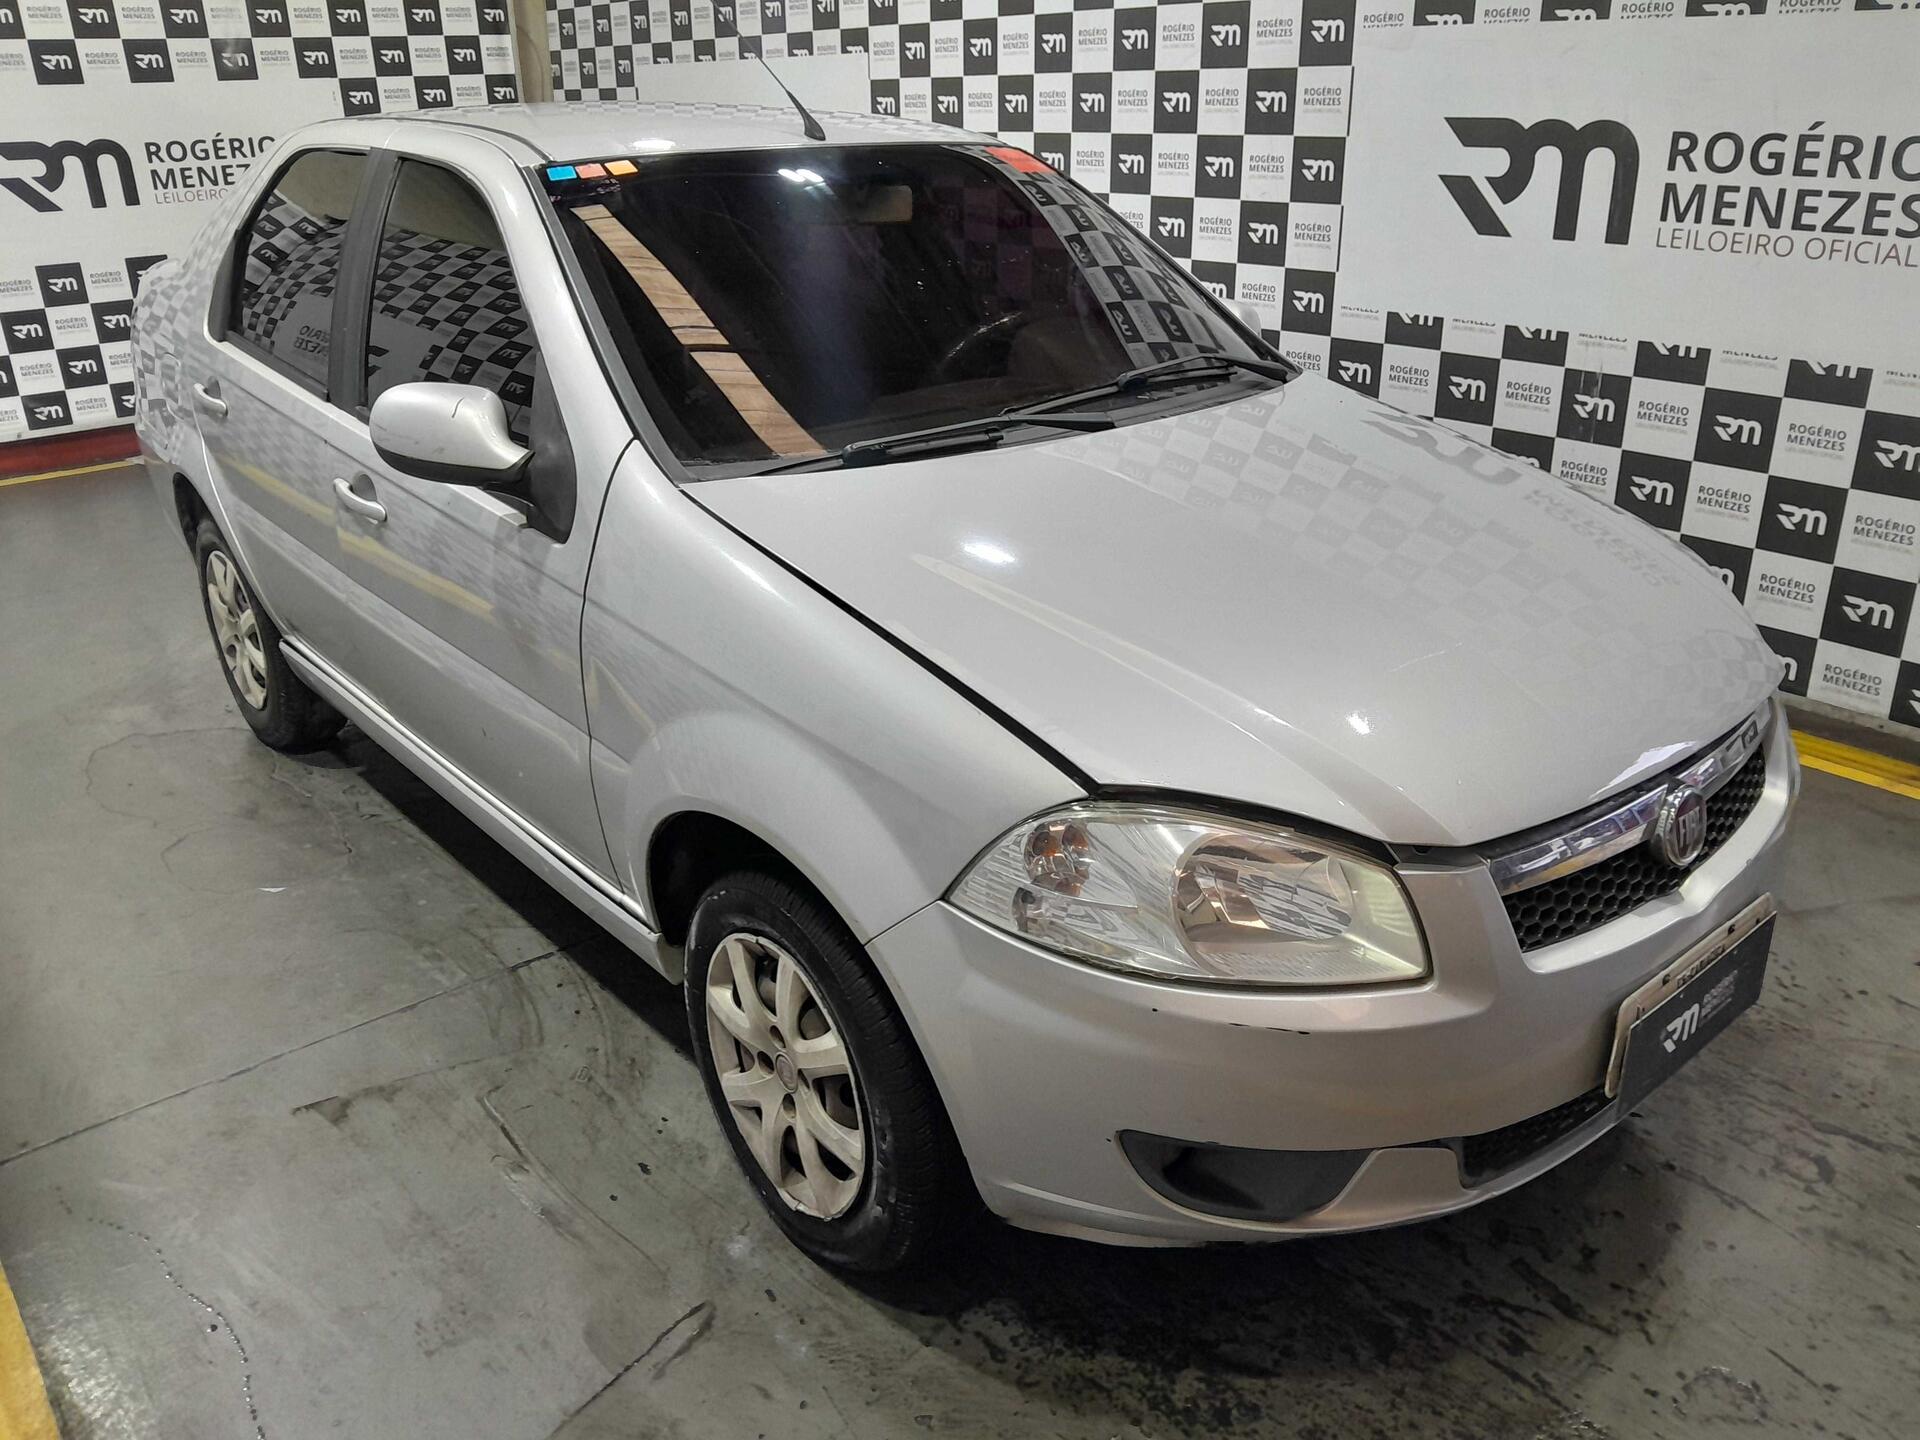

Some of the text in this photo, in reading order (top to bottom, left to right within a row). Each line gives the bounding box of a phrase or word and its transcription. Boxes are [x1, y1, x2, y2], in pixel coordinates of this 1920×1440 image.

[1484, 7, 1531, 18] ROGÉRIO
[1257, 18, 1293, 29] ROGÉRIO
[1363, 13, 1404, 24] ROGÉRIO
[1078, 28, 1107, 37] ROGÉRIO
[1163, 23, 1194, 33] ROGÉRIO
[1257, 28, 1293, 38] MENEZES
[1078, 37, 1108, 46] MENEZES
[1162, 33, 1194, 42] MENEZES
[1039, 91, 1066, 99] ROGÉRIO
[1118, 88, 1148, 98] ROGÉRIO
[1206, 88, 1239, 97] ROGÉRIO
[1304, 86, 1341, 97] ROGÉRIO
[1039, 98, 1067, 107] MENEZES
[1117, 97, 1148, 106] MENEZES
[1205, 97, 1239, 106] MENEZES
[1303, 96, 1341, 106] MENEZES
[1077, 150, 1104, 159] ROGÉRIO
[1158, 152, 1189, 161] ROGÉRIO
[1249, 154, 1285, 164] ROGÉRIO
[1076, 158, 1105, 167] MENEZES
[1158, 161, 1190, 170] MENEZES
[1249, 163, 1285, 173] MENEZES
[1437, 117, 1640, 245] RM
[1200, 216, 1232, 226] ROGÉRIO
[1199, 225, 1232, 236] MENEZES
[1294, 222, 1332, 233] ROGÉRIO
[1294, 232, 1331, 242] MENEZES
[1656, 227, 1918, 268] LEILOEIRO OFICIAL
[1242, 283, 1276, 294] ROGÉRIO
[1241, 292, 1276, 303] MENEZES
[1286, 350, 1322, 363] ROGÉRIO
[1389, 364, 1430, 378] ROGÉRIO
[1388, 374, 1429, 387] MENEZES
[1506, 381, 1552, 396] ROGÉRIO
[1505, 390, 1551, 406] MENEZES
[1638, 400, 1689, 416] ROGÉRIO
[1637, 411, 1689, 427] MENEZES
[1788, 423, 1847, 441] ROGÉRIO
[1787, 433, 1846, 452] MENEZES
[1561, 460, 1608, 476] ROGÉRIO
[1560, 470, 1607, 486] MENEZES
[1698, 485, 1752, 503] ROGÉRIO
[1696, 495, 1751, 514] MENEZES
[1855, 514, 1916, 535] ROGÉRIO
[1853, 525, 1914, 546] MENEZES
[1760, 573, 1817, 594] ROGÉRIO
[1758, 583, 1815, 604] MENEZES
[1824, 663, 1883, 686] ROGÉRIO
[1822, 673, 1881, 697] MENEZES
